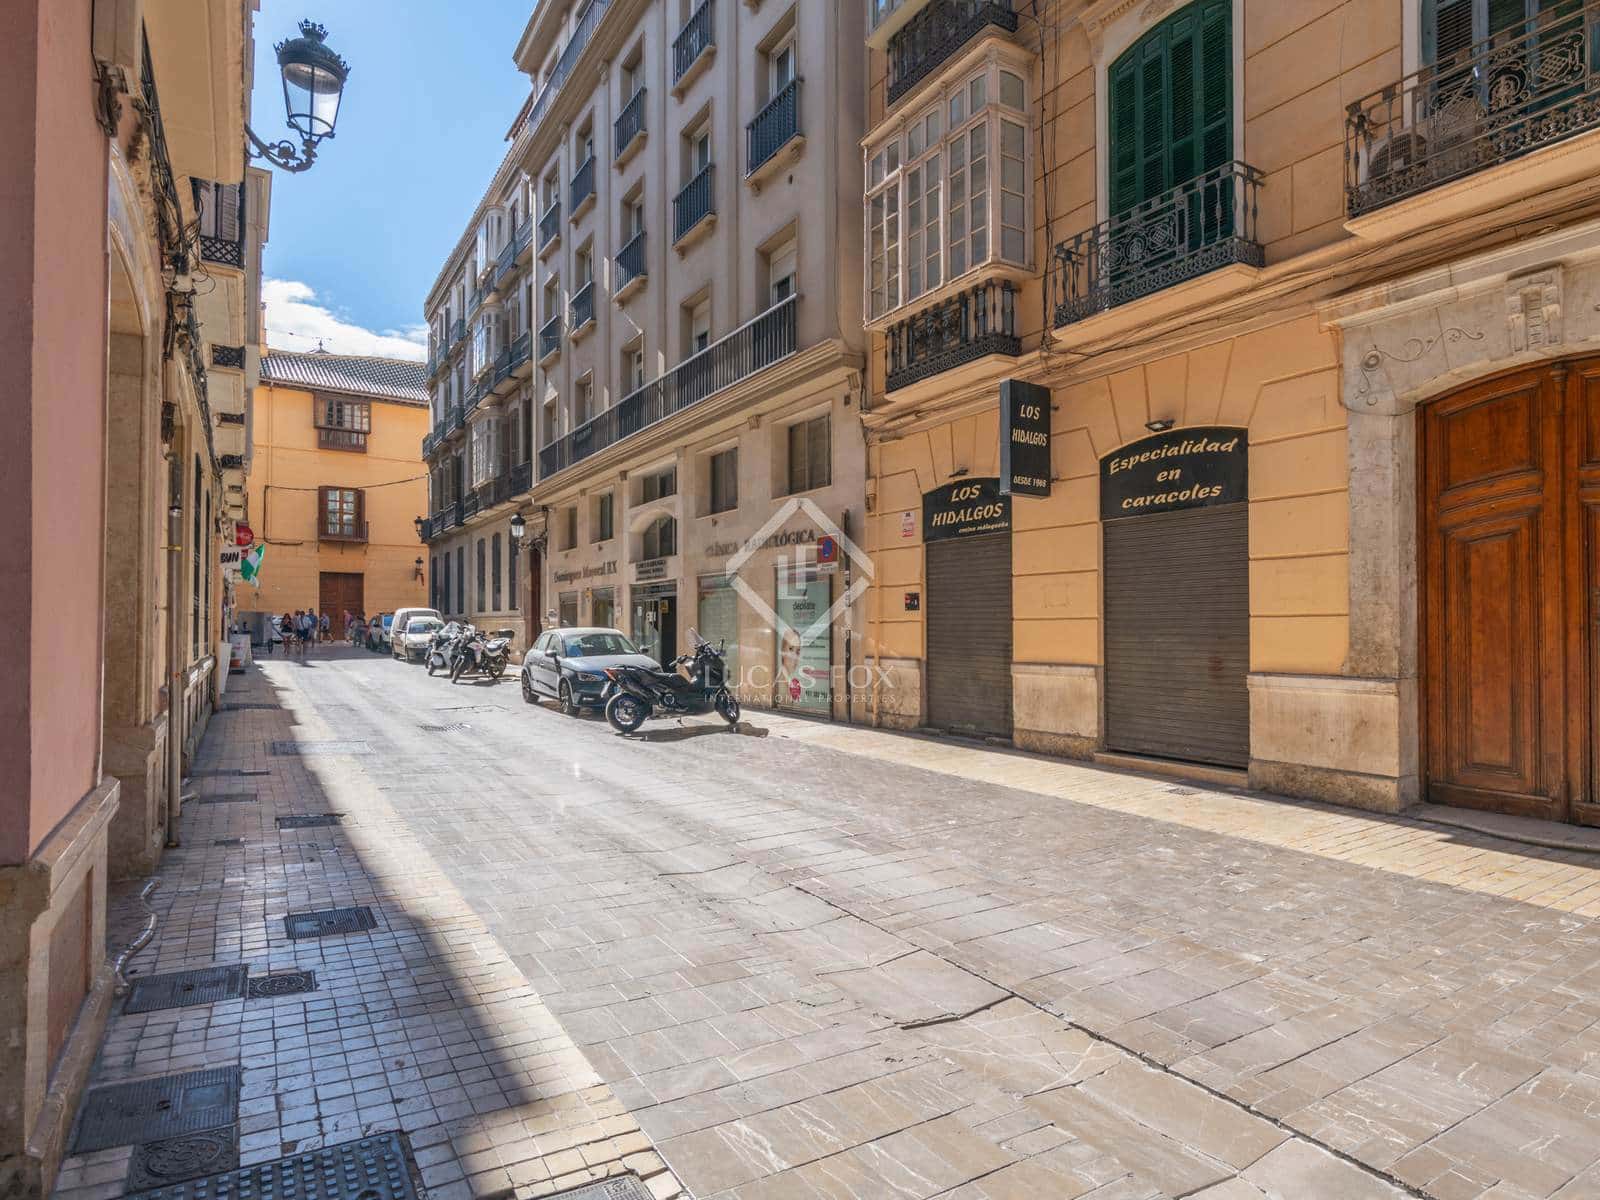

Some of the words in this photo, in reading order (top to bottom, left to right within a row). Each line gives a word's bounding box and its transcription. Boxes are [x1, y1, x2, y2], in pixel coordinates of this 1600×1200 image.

[1020, 404, 1041, 420] LOS
[1011, 428, 1048, 447] HIDALGOS
[1109, 437, 1239, 475] Especialidad
[1013, 475, 1032, 487] DESDE
[1156, 468, 1182, 483] en
[950, 485, 982, 502] LOS
[1121, 483, 1223, 509] caracoles
[931, 503, 1004, 527] HIDALGOS
